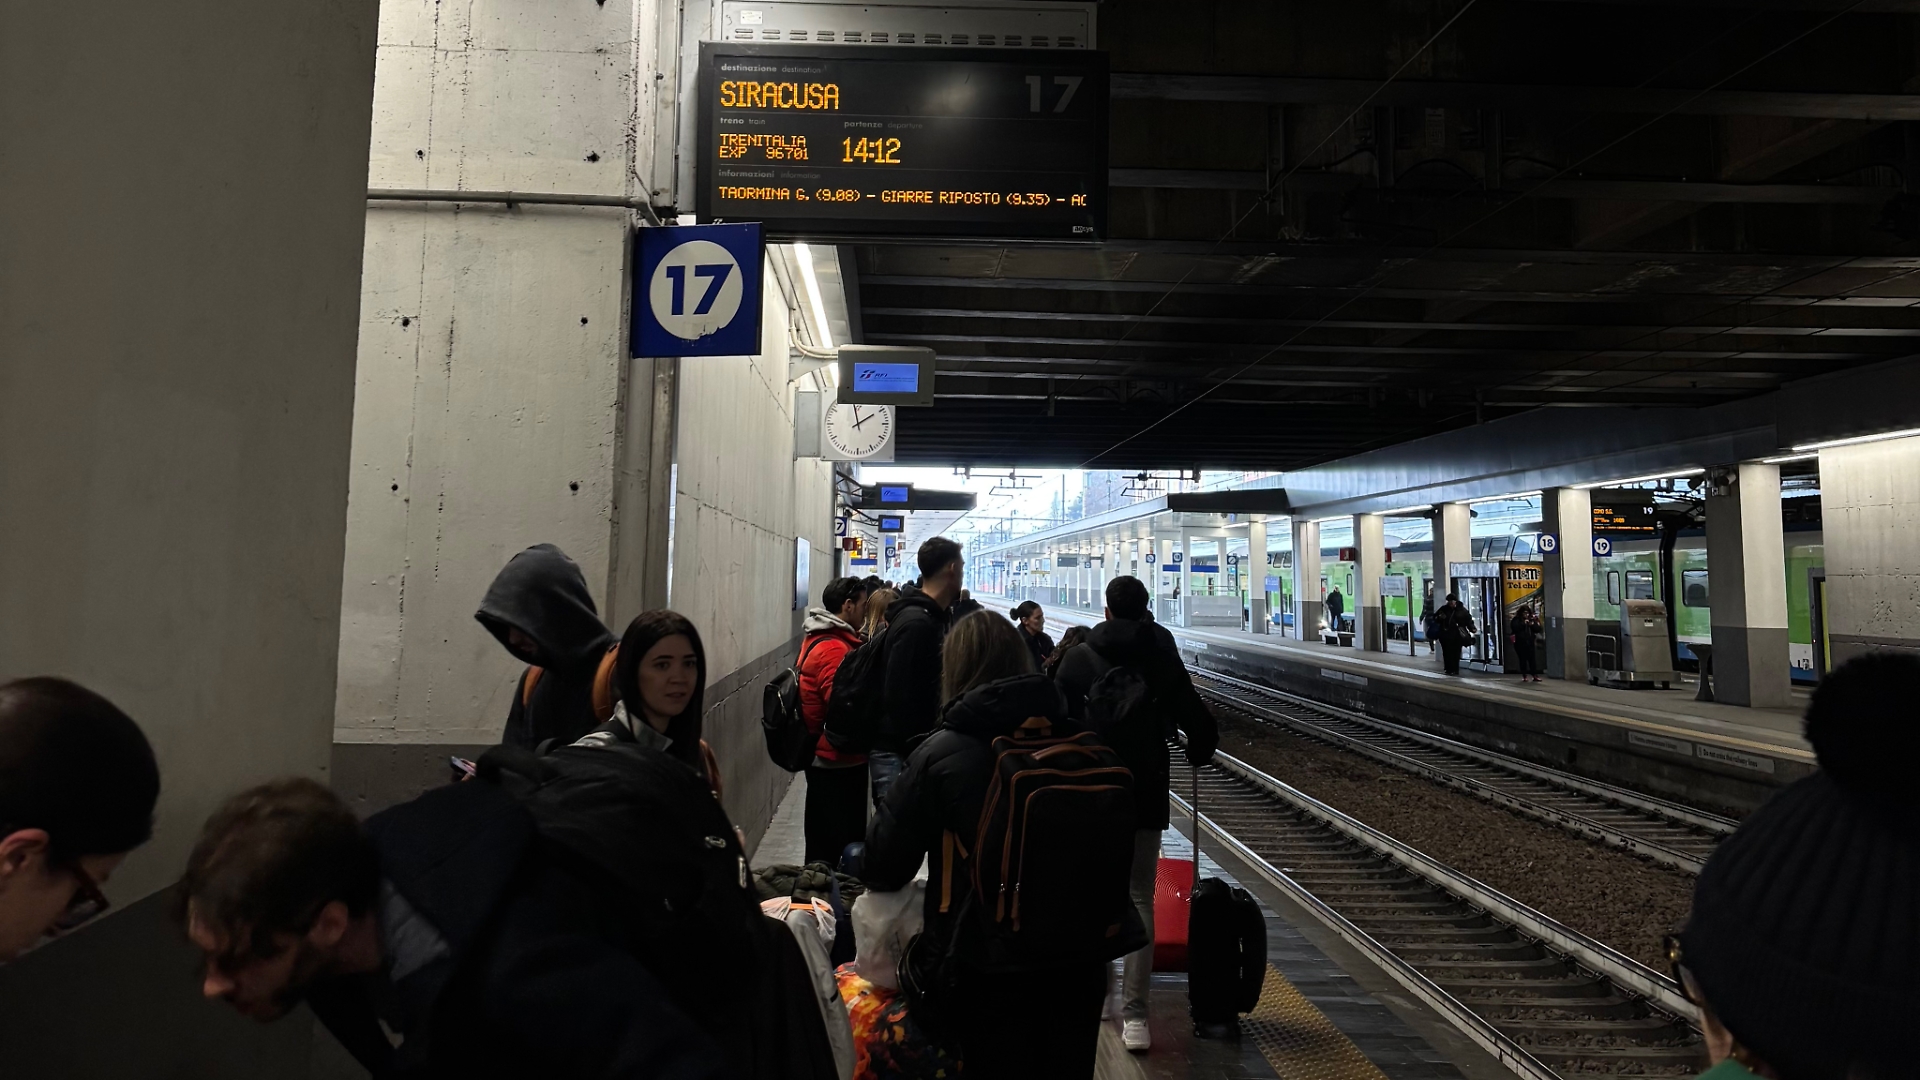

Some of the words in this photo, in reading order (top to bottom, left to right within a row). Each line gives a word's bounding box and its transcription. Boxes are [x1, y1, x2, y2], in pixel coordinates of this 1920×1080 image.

[721, 63, 777, 72] destinazione
[781, 65, 821, 74] destination
[720, 81, 839, 110] SIRACUSA
[1025, 75, 1085, 113] 17
[720, 117, 745, 125] treno
[748, 118, 766, 126] train
[844, 120, 883, 129] partenze
[719, 134, 807, 147] TRENITALIA
[719, 147, 748, 159] EXP
[766, 147, 809, 160] 96701
[842, 136, 902, 164] 14:12
[718, 169, 775, 178] informazioni
[780, 171, 821, 180] information
[719, 186, 790, 200] TAORMINA
[796, 188, 810, 201] G.
[815, 188, 861, 202] (9.08)
[881, 190, 934, 203] GIARRE
[939, 191, 1001, 205] RIPOSTO
[1006, 192, 1051, 206] (9.35)
[666, 263, 735, 316] 17
[1643, 507, 1653, 515] 19
[1542, 538, 1553, 548] 18
[1596, 542, 1608, 551] 19
